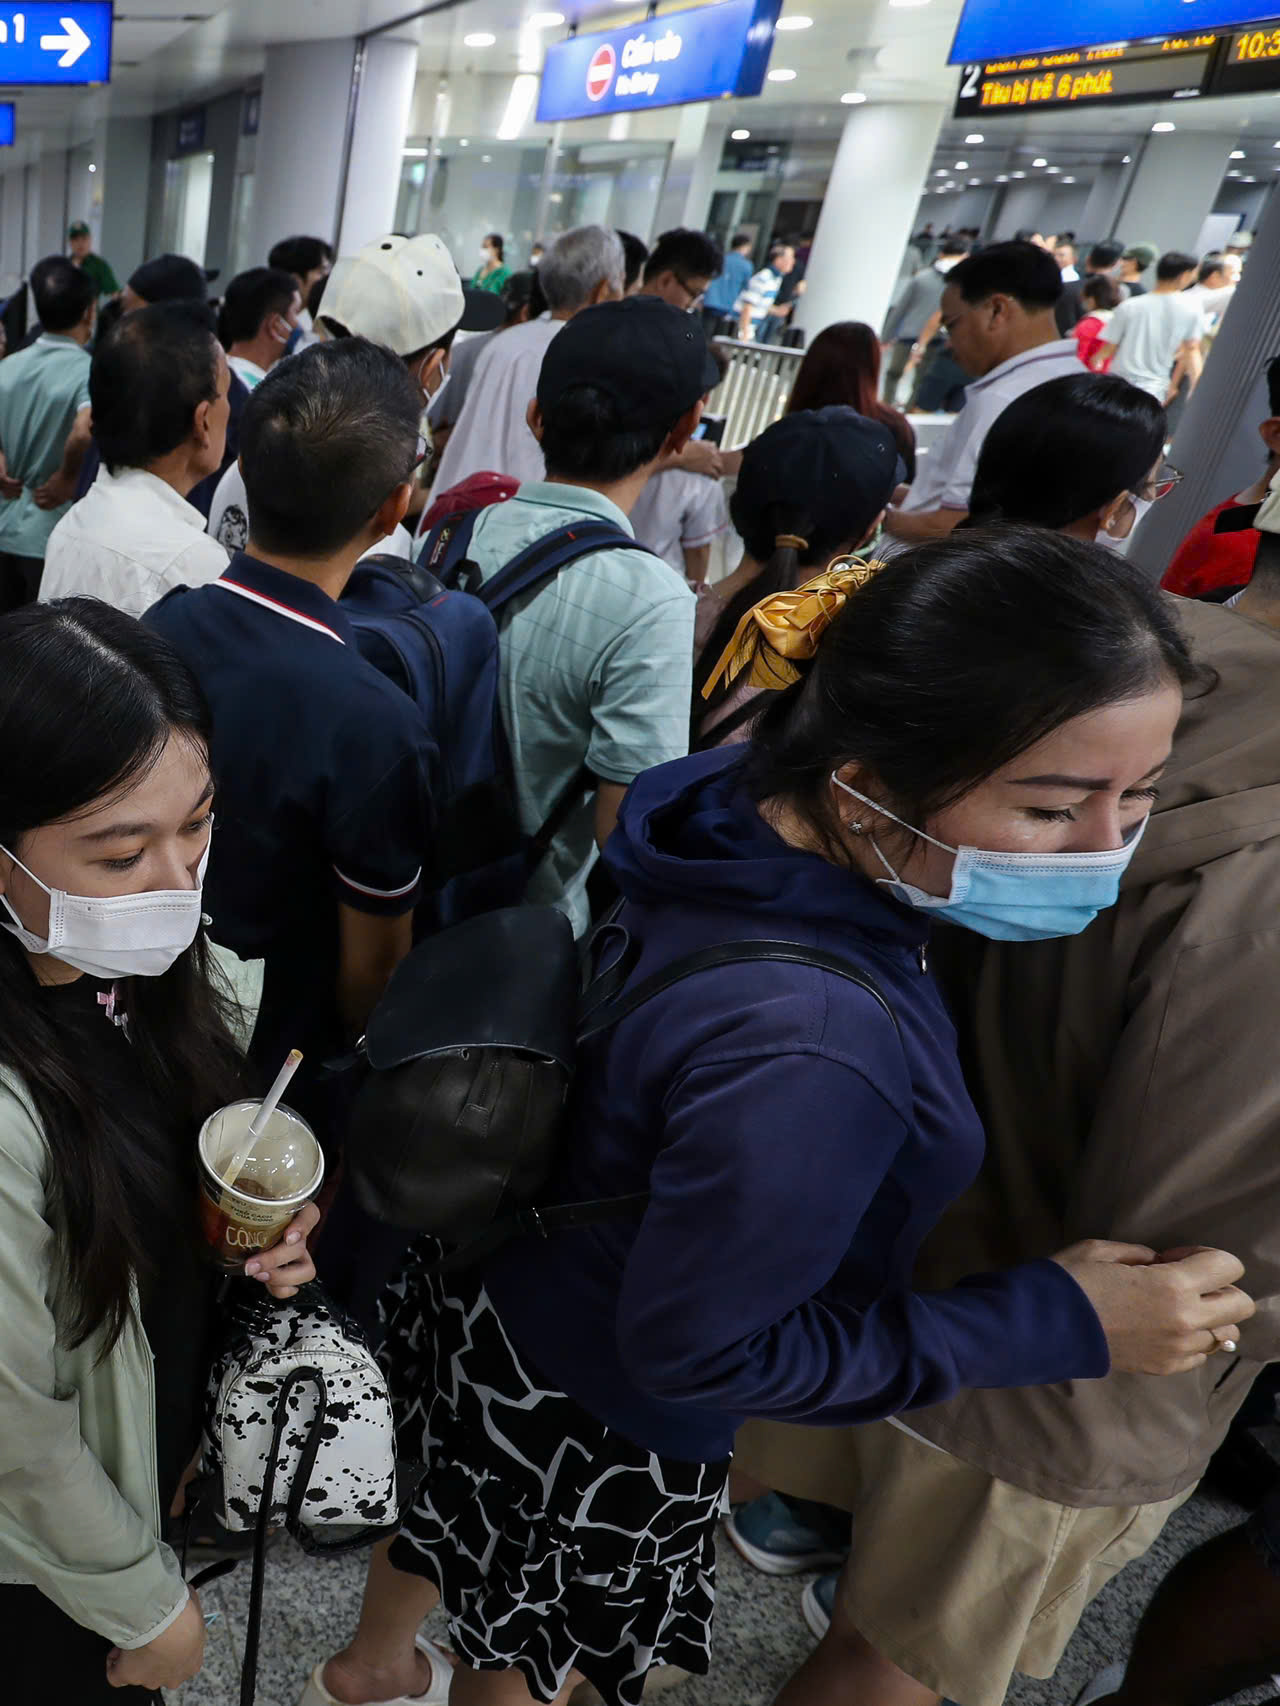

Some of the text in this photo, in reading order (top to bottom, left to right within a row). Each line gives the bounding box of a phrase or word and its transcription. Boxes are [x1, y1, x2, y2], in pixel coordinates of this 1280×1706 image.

[13, 13, 25, 43] 1
[959, 64, 981, 98] 2
[1056, 73, 1072, 98] 6
